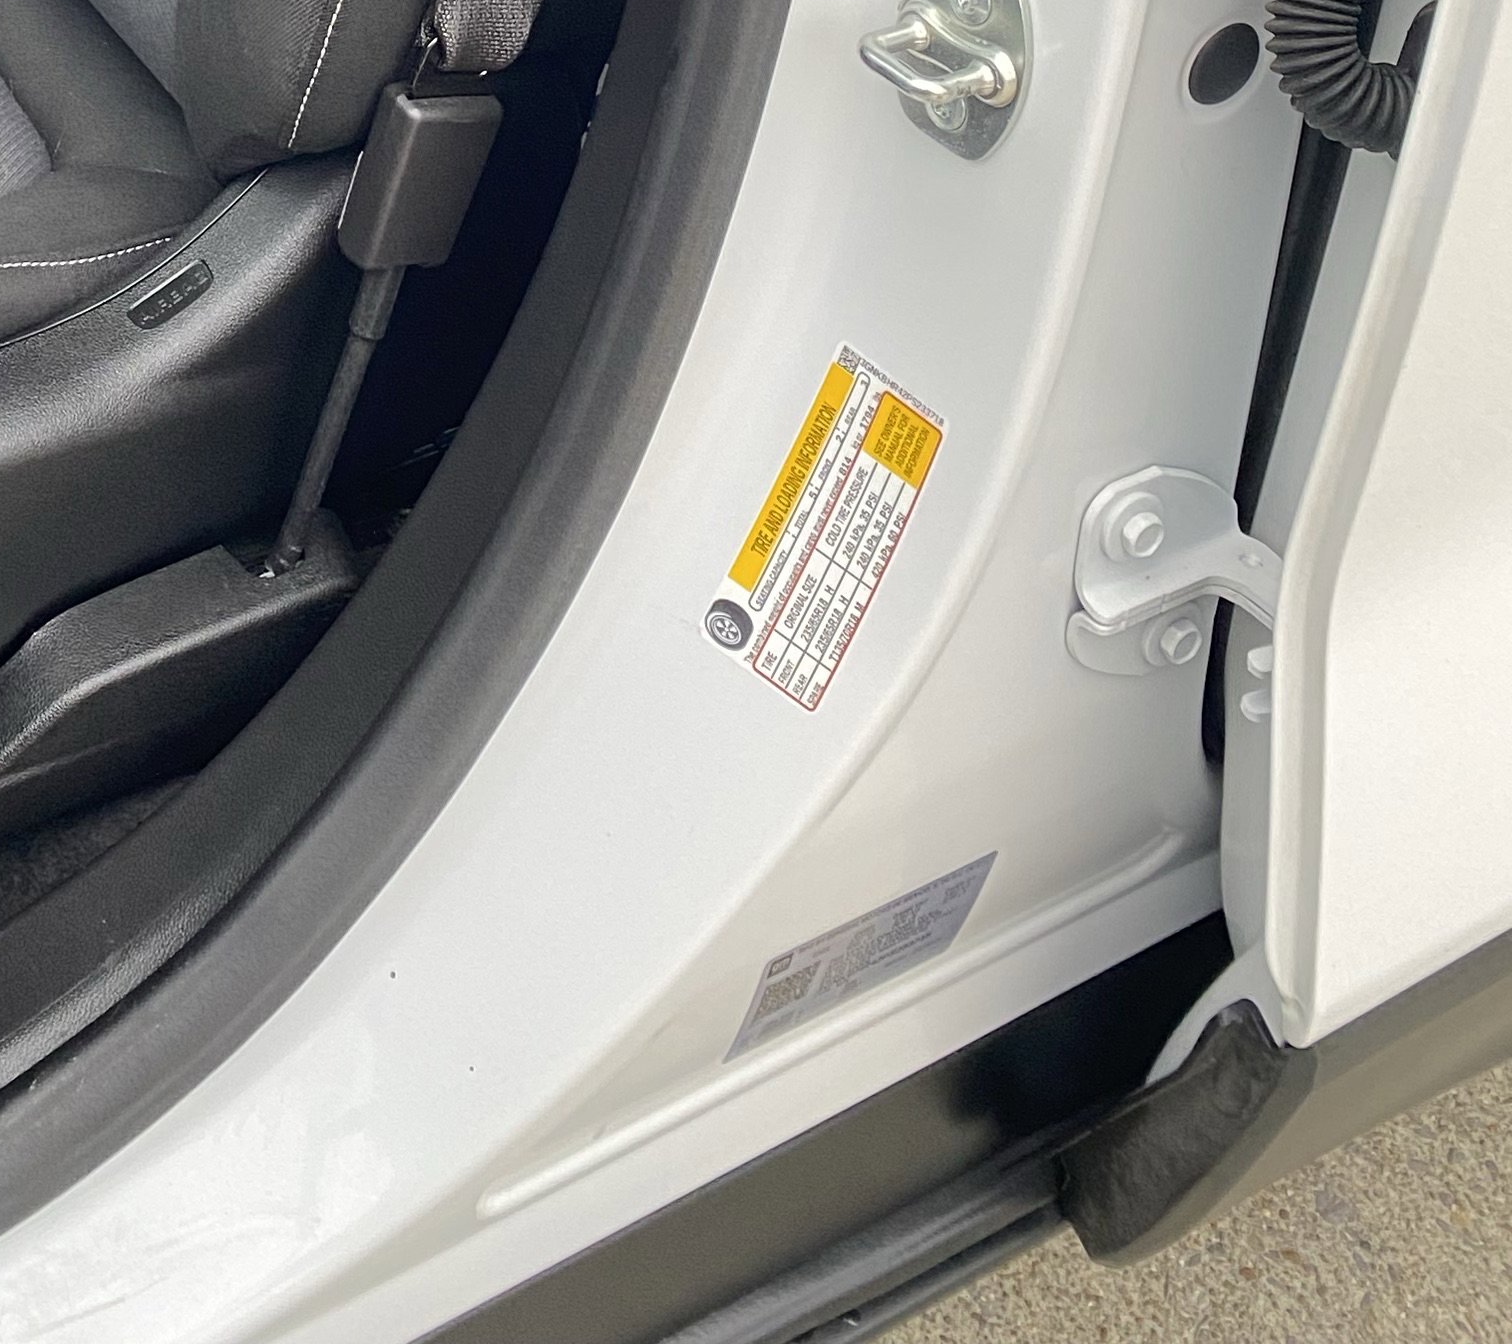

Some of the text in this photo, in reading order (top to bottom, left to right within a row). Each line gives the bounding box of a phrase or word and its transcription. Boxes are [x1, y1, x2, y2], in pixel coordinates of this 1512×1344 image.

[837, 454, 853, 476] 814
[858, 403, 876, 430] 1794
[872, 404, 902, 458] SEE OWNER'S
[882, 411, 911, 464] MANUAL FOR
[891, 422, 920, 469] ADDITIONAL
[900, 425, 932, 479] INFORMATION
[749, 399, 837, 560] TIRE AND LOADING INFORMATION
[754, 577, 774, 608] SEATING
[768, 548, 788, 581] CAPACITY
[793, 507, 809, 530] TOTAL
[807, 489, 817, 500] 5
[834, 433, 844, 444] 2
[859, 378, 869, 389] 3
[872, 518, 885, 533] 35
[878, 500, 893, 520] PSI
[892, 510, 907, 530] PSI
[886, 528, 899, 543] 60
[760, 465, 869, 673] TIRE ORIGINAL SIZE COLD TIRE PRESSURE
[855, 549, 870, 570] 240
[869, 559, 884, 580] 420
[777, 657, 795, 686] FRONT
[799, 595, 829, 644] 235/65R18
[823, 583, 835, 596] H
[841, 540, 856, 559] 240
[858, 507, 870, 522] 35
[864, 490, 878, 509] PSI
[837, 593, 849, 607] H
[853, 600, 865, 613] M
[814, 606, 843, 655] 235/65R18
[791, 672, 808, 696] REAR
